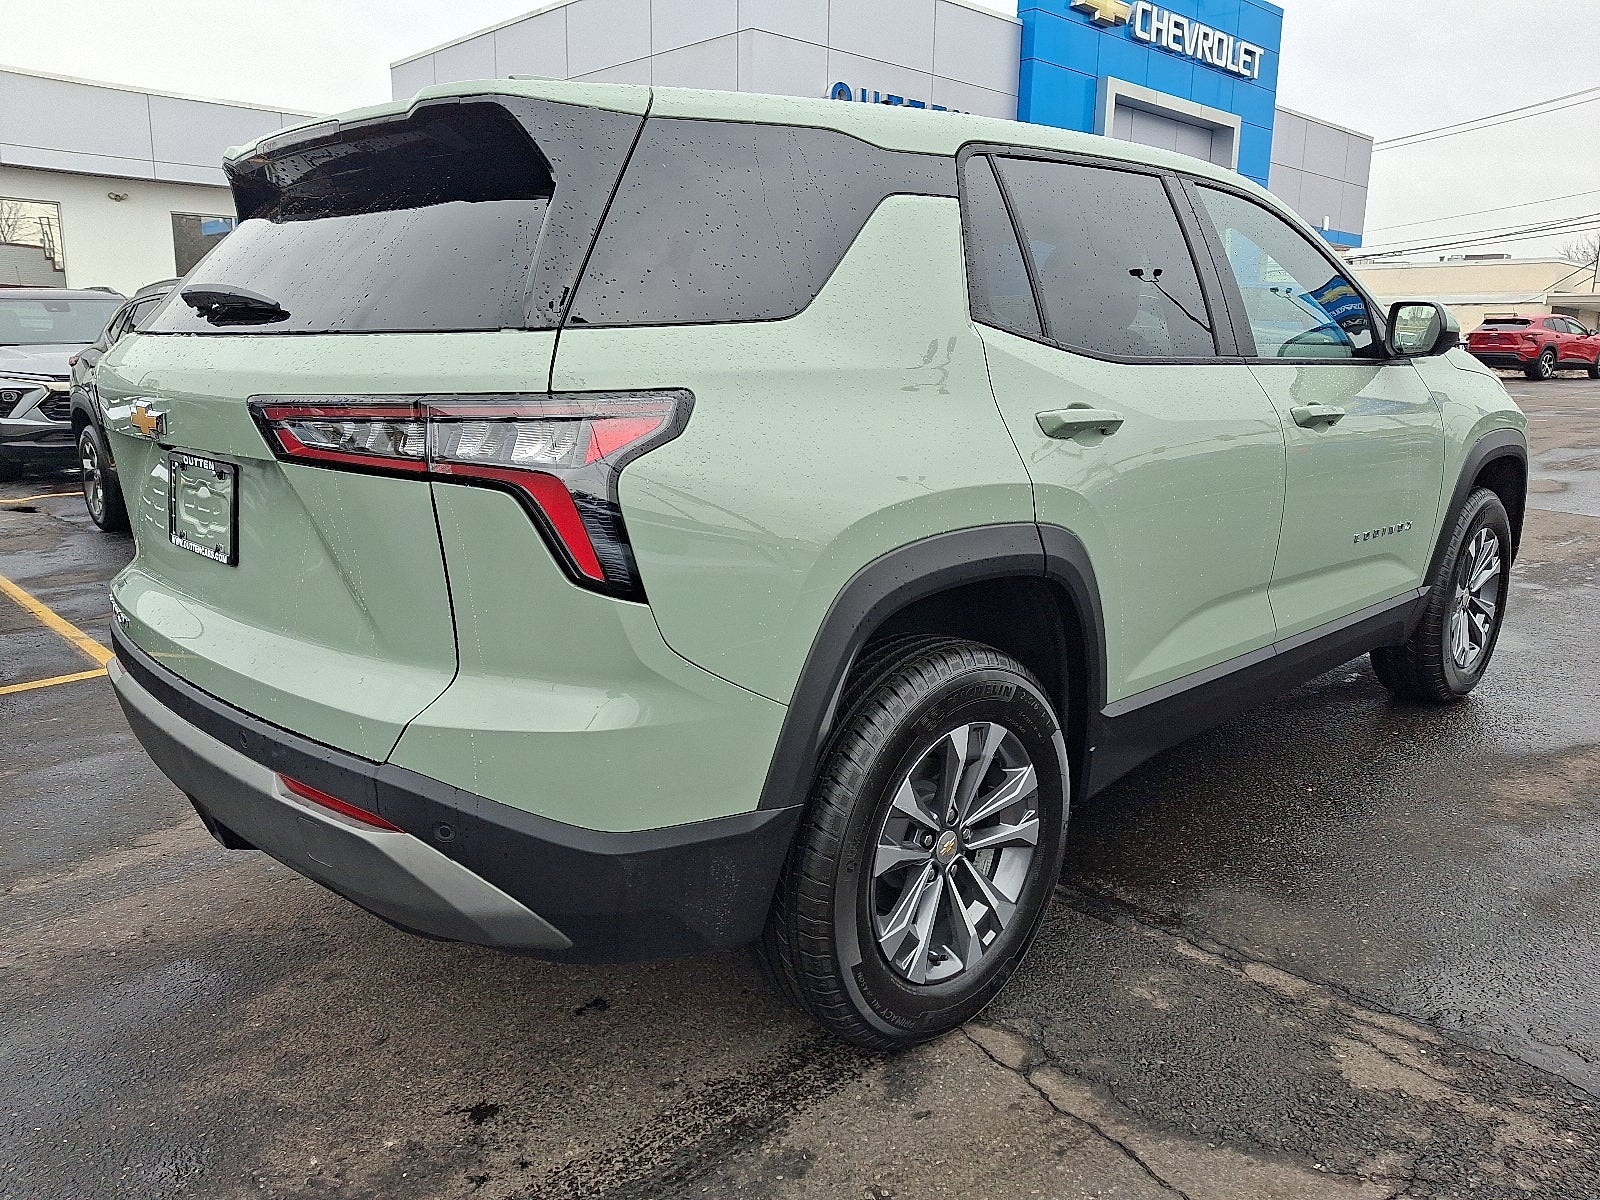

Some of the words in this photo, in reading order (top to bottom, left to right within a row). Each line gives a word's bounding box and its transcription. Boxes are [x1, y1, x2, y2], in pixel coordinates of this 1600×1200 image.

[1133, 1, 1264, 79] CHEVROLET
[183, 455, 215, 470] OUTTEN
[1353, 520, 1413, 543] EQUINOX
